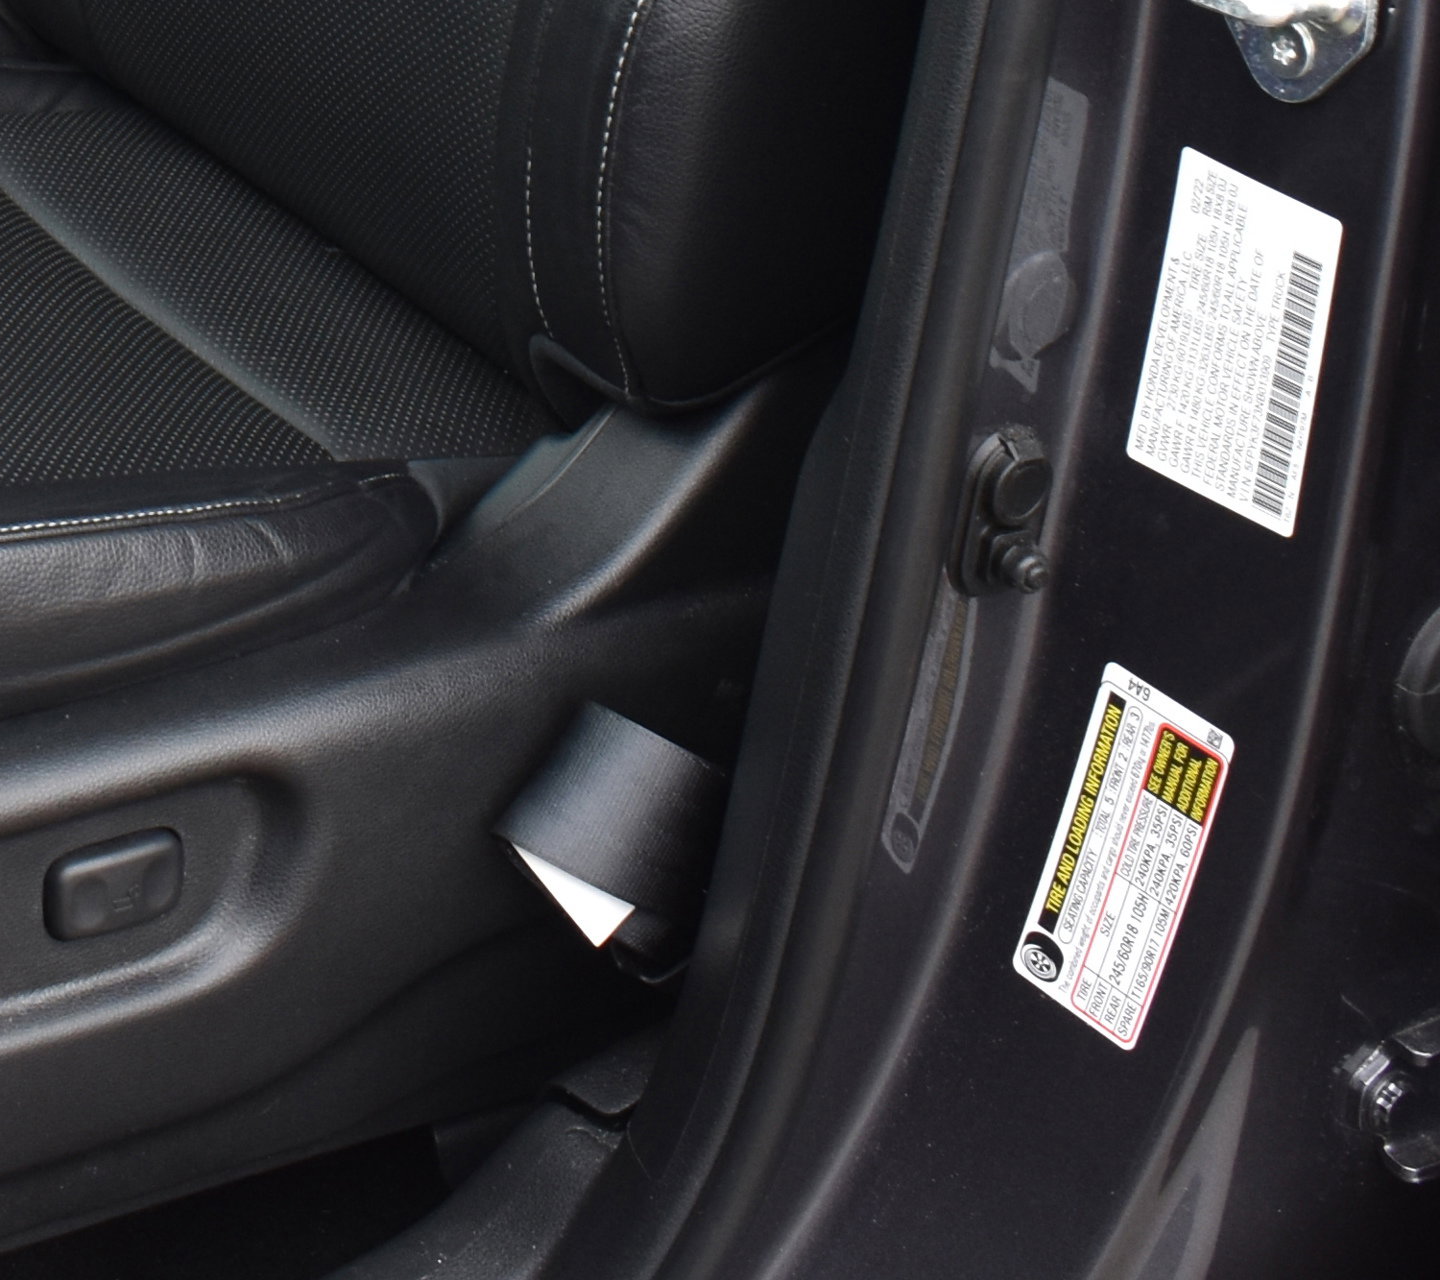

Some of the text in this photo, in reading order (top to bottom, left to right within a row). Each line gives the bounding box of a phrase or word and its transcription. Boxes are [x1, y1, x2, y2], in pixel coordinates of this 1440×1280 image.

[1188, 262, 1202, 291] TIRE
[1193, 232, 1207, 262] SIZE
[1152, 265, 1177, 357] DEVELOPMENT
[1271, 269, 1287, 311] TRUCK
[1190, 202, 1248, 480] THIS VEHICLE CONFORMS TO ALL APPLICABLE
[1265, 312, 1279, 344] TYPE
[1143, 355, 1161, 402] HONDA
[1145, 352, 1173, 458] MANUFACTURING
[1164, 332, 1177, 353] OF
[1202, 275, 1248, 486] FEDERAL MOTOR VEHICLE SAFETY
[1214, 247, 1265, 492] STANDARDS IN EFFECT ON THE DATE OF
[1140, 400, 1152, 420] BY
[1226, 310, 1267, 499] MANUFACTURE SHOWN ABOVE
[1157, 422, 1172, 463] GVWR
[1168, 428, 1183, 469] GAWR
[1179, 434, 1195, 474] GAWR
[1146, 728, 1176, 795] SEE OWNER'S
[1160, 740, 1189, 804] MANUAL FOR
[1174, 755, 1202, 813] ADDITIONAL
[1189, 756, 1220, 823] INFORMATION
[1045, 702, 1122, 916] TIRE AND LOADING INFORMATION
[1062, 710, 1141, 934] SEATING CAPACITY TOTAL 5 FRONT 2 REAR 3
[1132, 794, 1154, 838] PRESSURE
[1126, 835, 1140, 855] TIRE
[1088, 802, 1168, 1018] FRONT 245/60R18 105H 240KPA, 35PSI
[1098, 909, 1116, 938] SIZE
[1103, 812, 1183, 1025] REAR 240KPA, 35PSI
[1117, 822, 1198, 1038] SPARE T165/90R17 105M 420KPA, 60PSI
[1076, 976, 1092, 1003] TIRE
